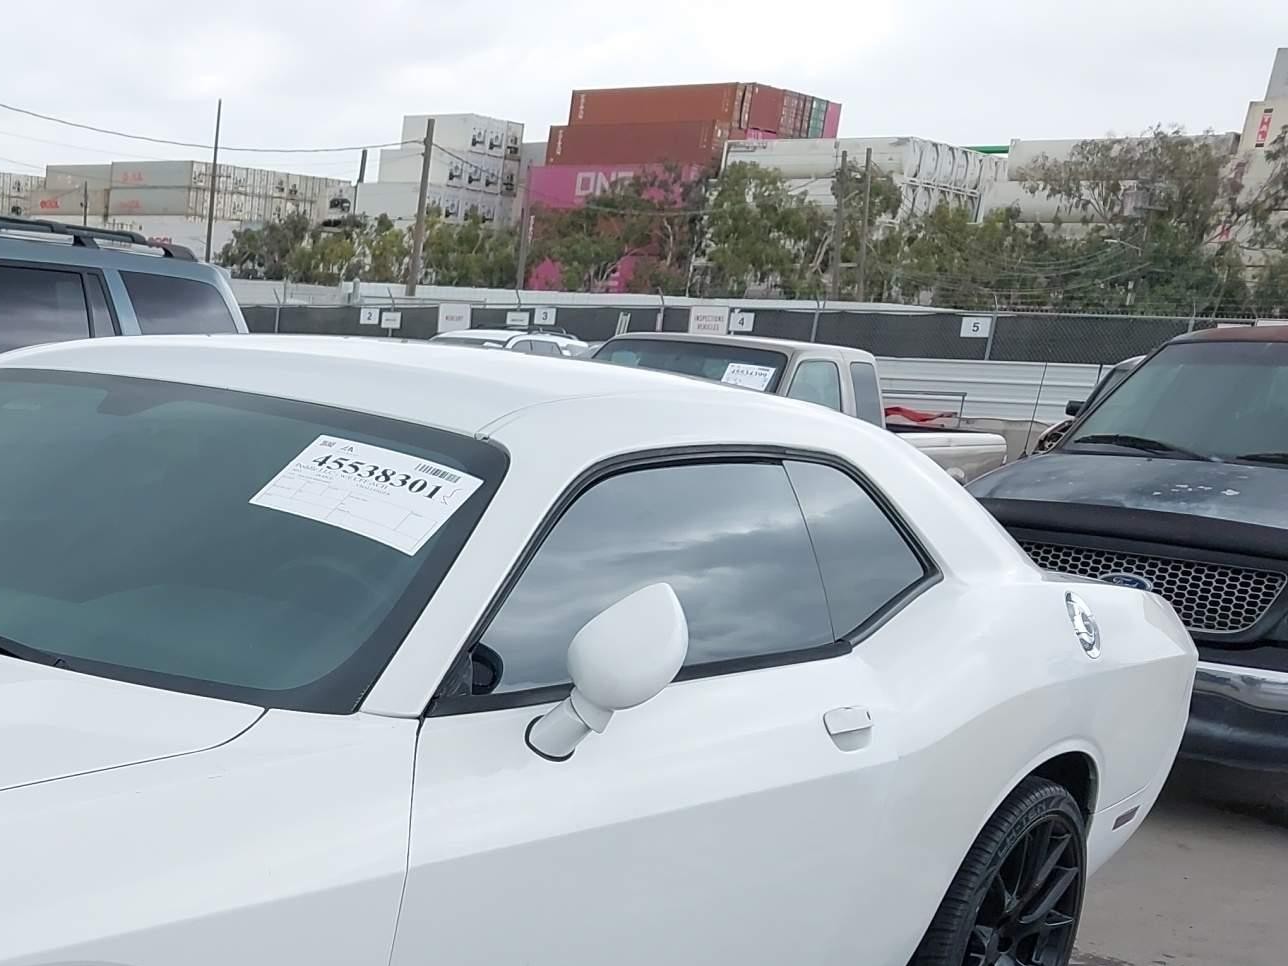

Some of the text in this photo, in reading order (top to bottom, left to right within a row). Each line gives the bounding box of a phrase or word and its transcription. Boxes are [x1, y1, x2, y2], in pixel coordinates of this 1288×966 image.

[367, 311, 373, 321] 2
[542, 311, 548, 321] 3
[738, 316, 745, 328] 4
[971, 321, 981, 333] 5
[312, 454, 442, 499] 45538301
